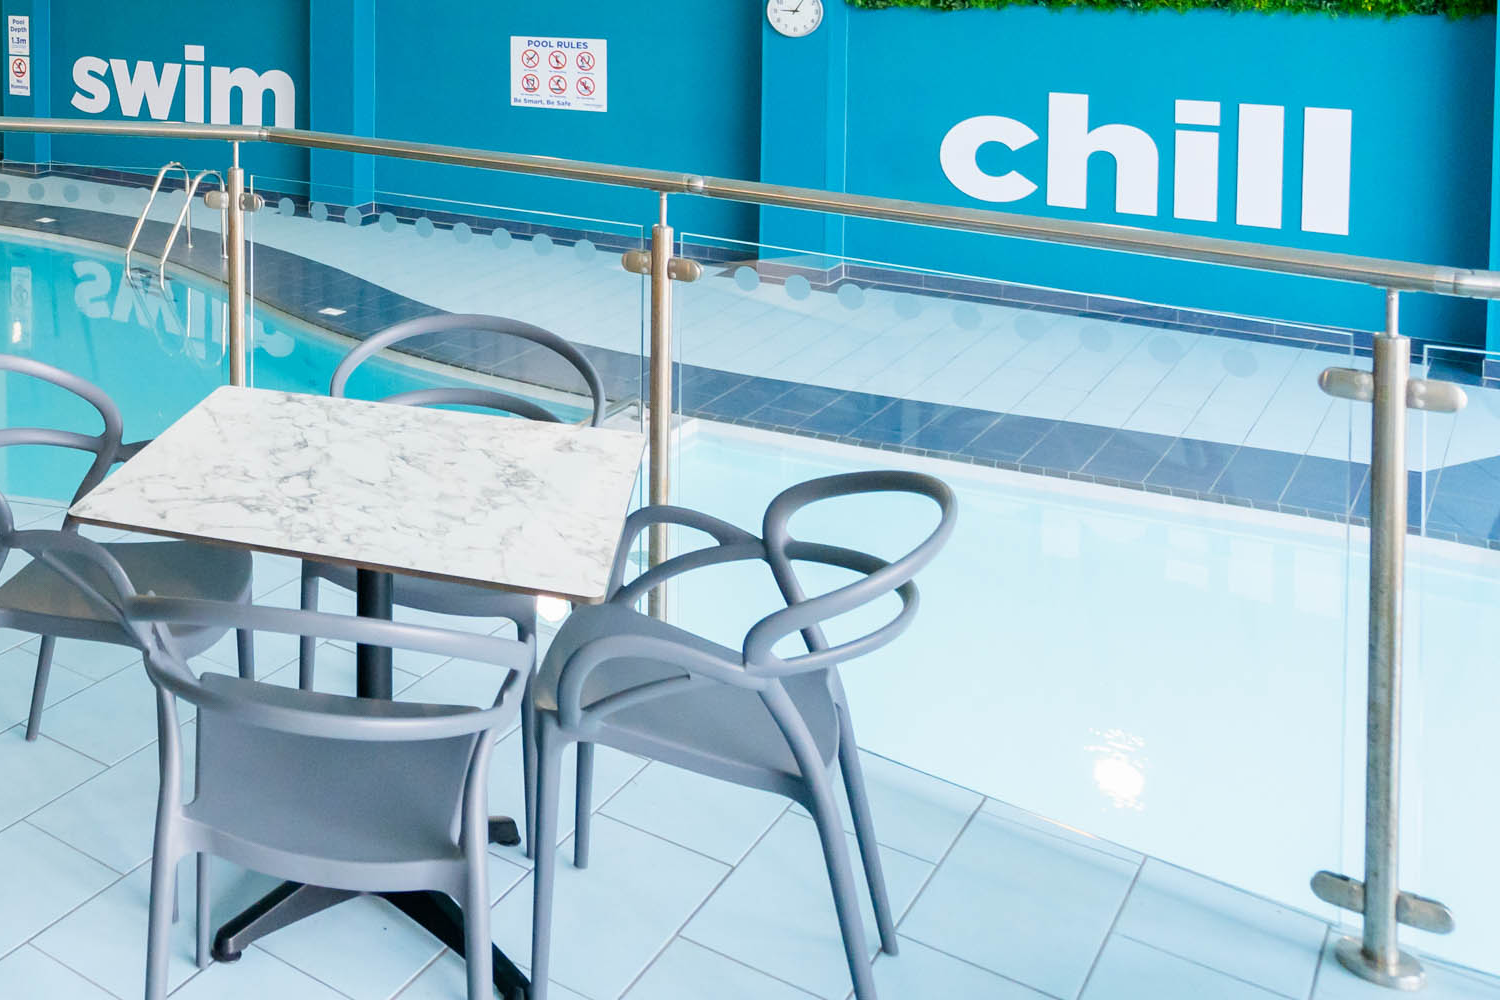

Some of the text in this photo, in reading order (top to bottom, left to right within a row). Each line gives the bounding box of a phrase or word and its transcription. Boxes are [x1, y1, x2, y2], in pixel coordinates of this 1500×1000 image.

[70, 44, 296, 128] swim
[527, 40, 589, 49] POOL RULES
[940, 92, 1352, 236] chill
